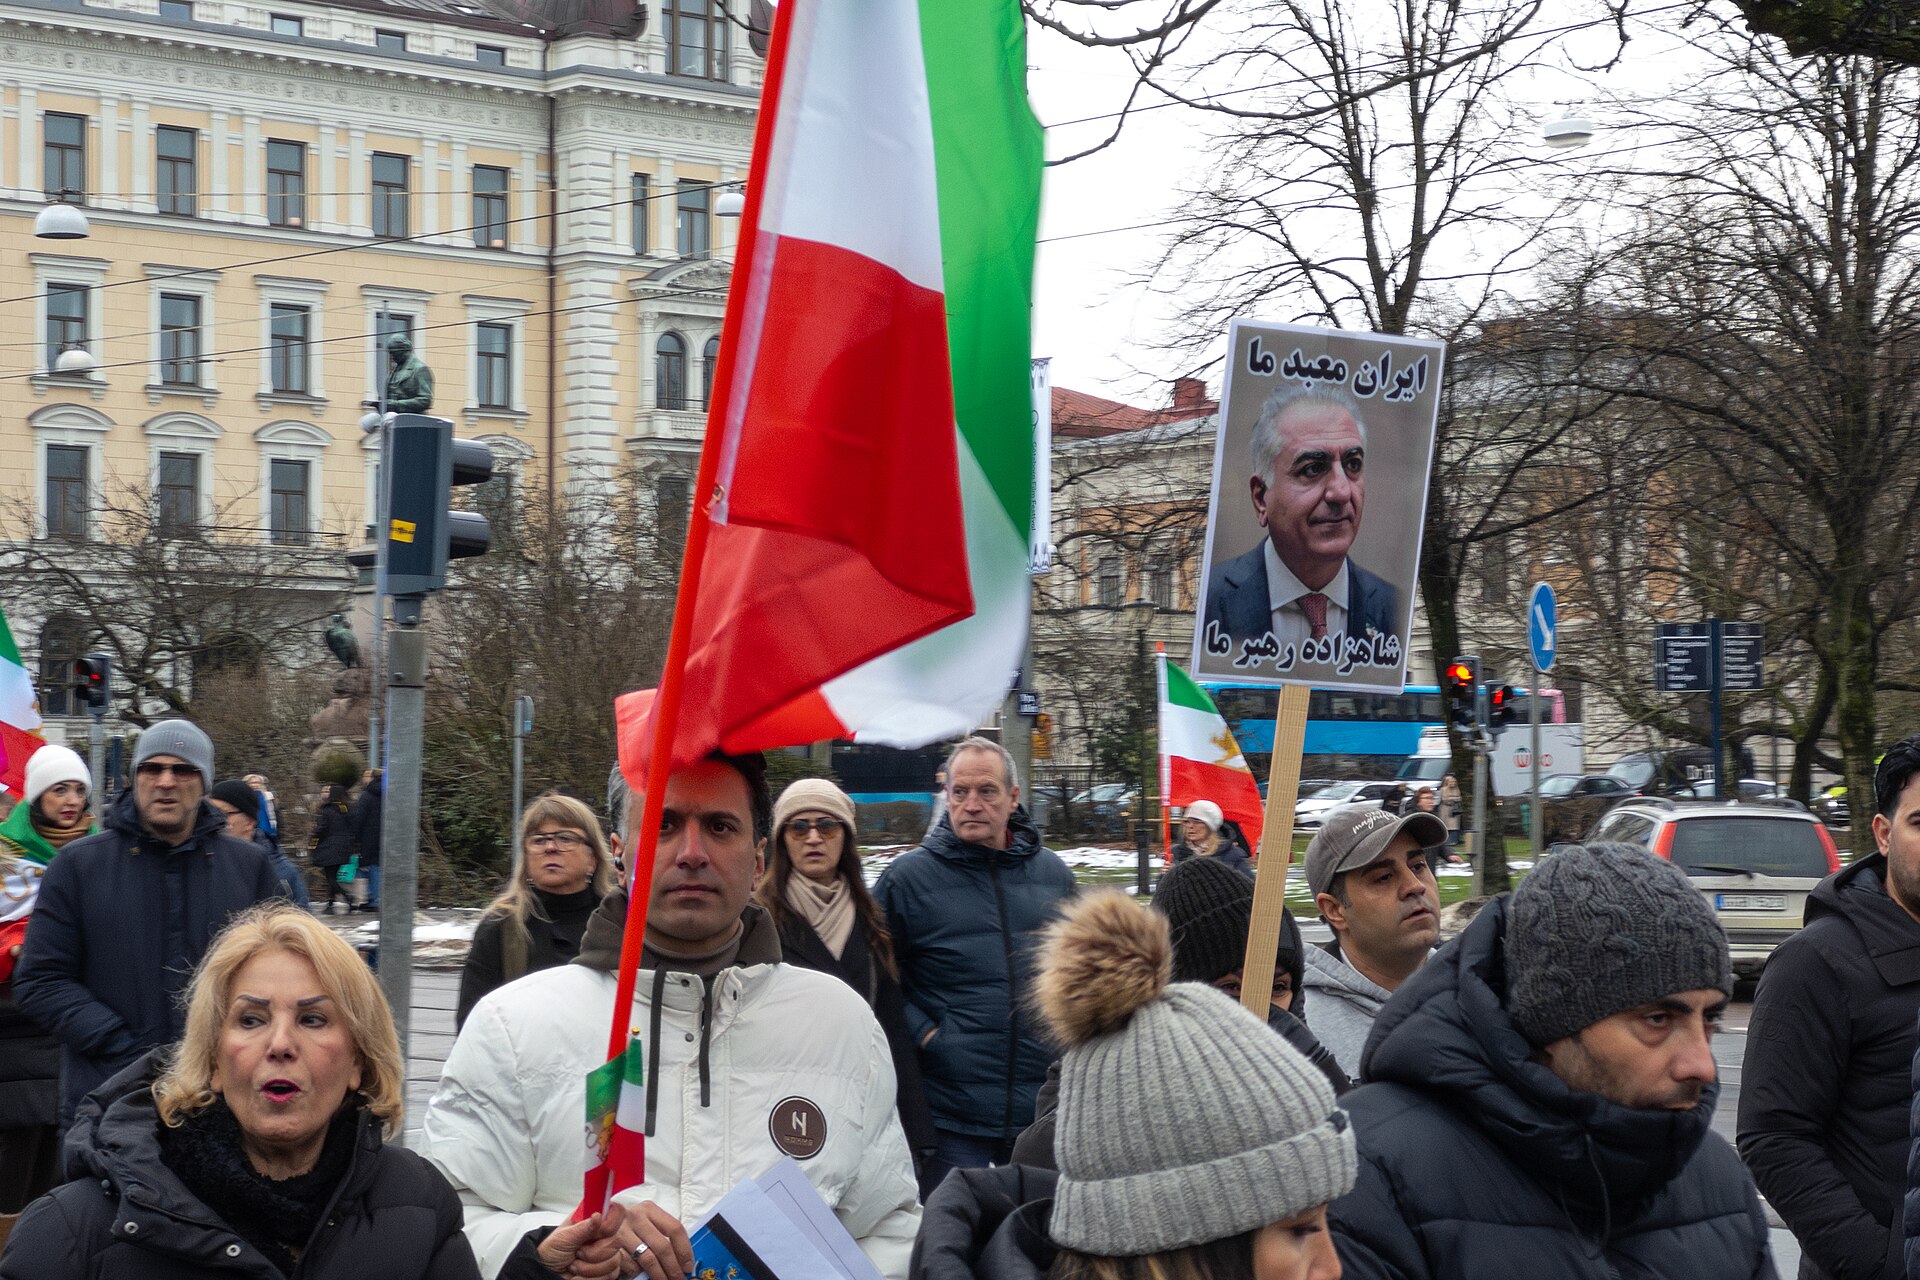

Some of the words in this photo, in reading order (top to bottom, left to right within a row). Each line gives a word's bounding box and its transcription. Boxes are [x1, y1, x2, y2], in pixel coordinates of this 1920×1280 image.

[1249, 337, 1276, 375] ما
[1282, 349, 1348, 388] معبد
[1353, 351, 1428, 400] ایران
[1207, 621, 1231, 656] ما
[1233, 632, 1296, 669] رهبر
[1301, 632, 1401, 674] شاهزاده
